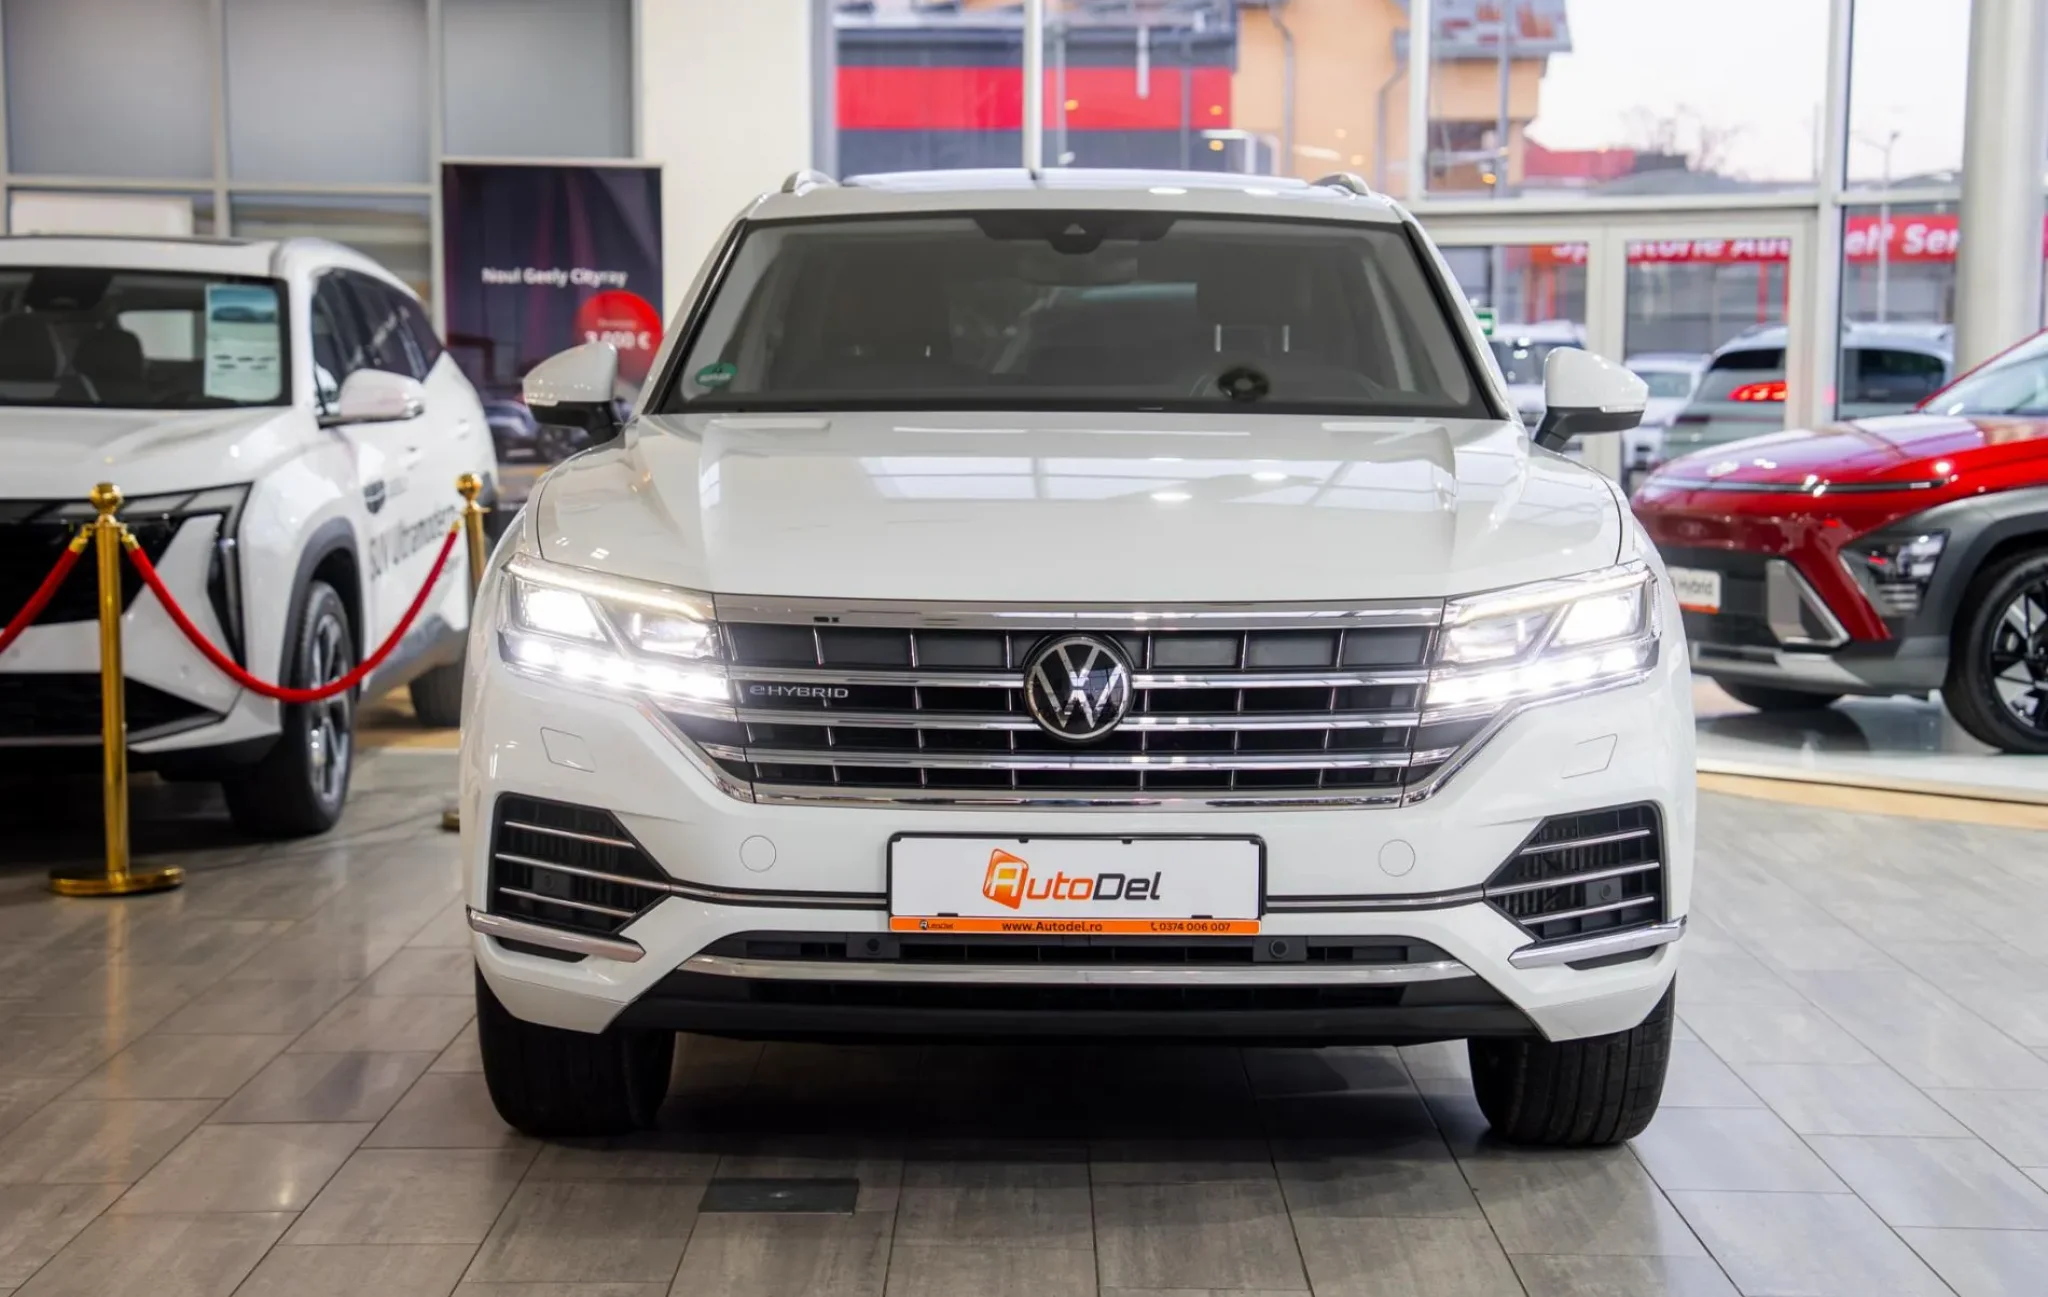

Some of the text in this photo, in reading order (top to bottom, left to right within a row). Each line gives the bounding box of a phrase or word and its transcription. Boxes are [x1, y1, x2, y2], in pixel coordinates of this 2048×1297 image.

[523, 267, 568, 288] Geely
[987, 851, 1162, 905] AutoDel
[1002, 922, 1103, 932] www.Autodel.ro
[1160, 922, 1231, 931] 0374 006 007
